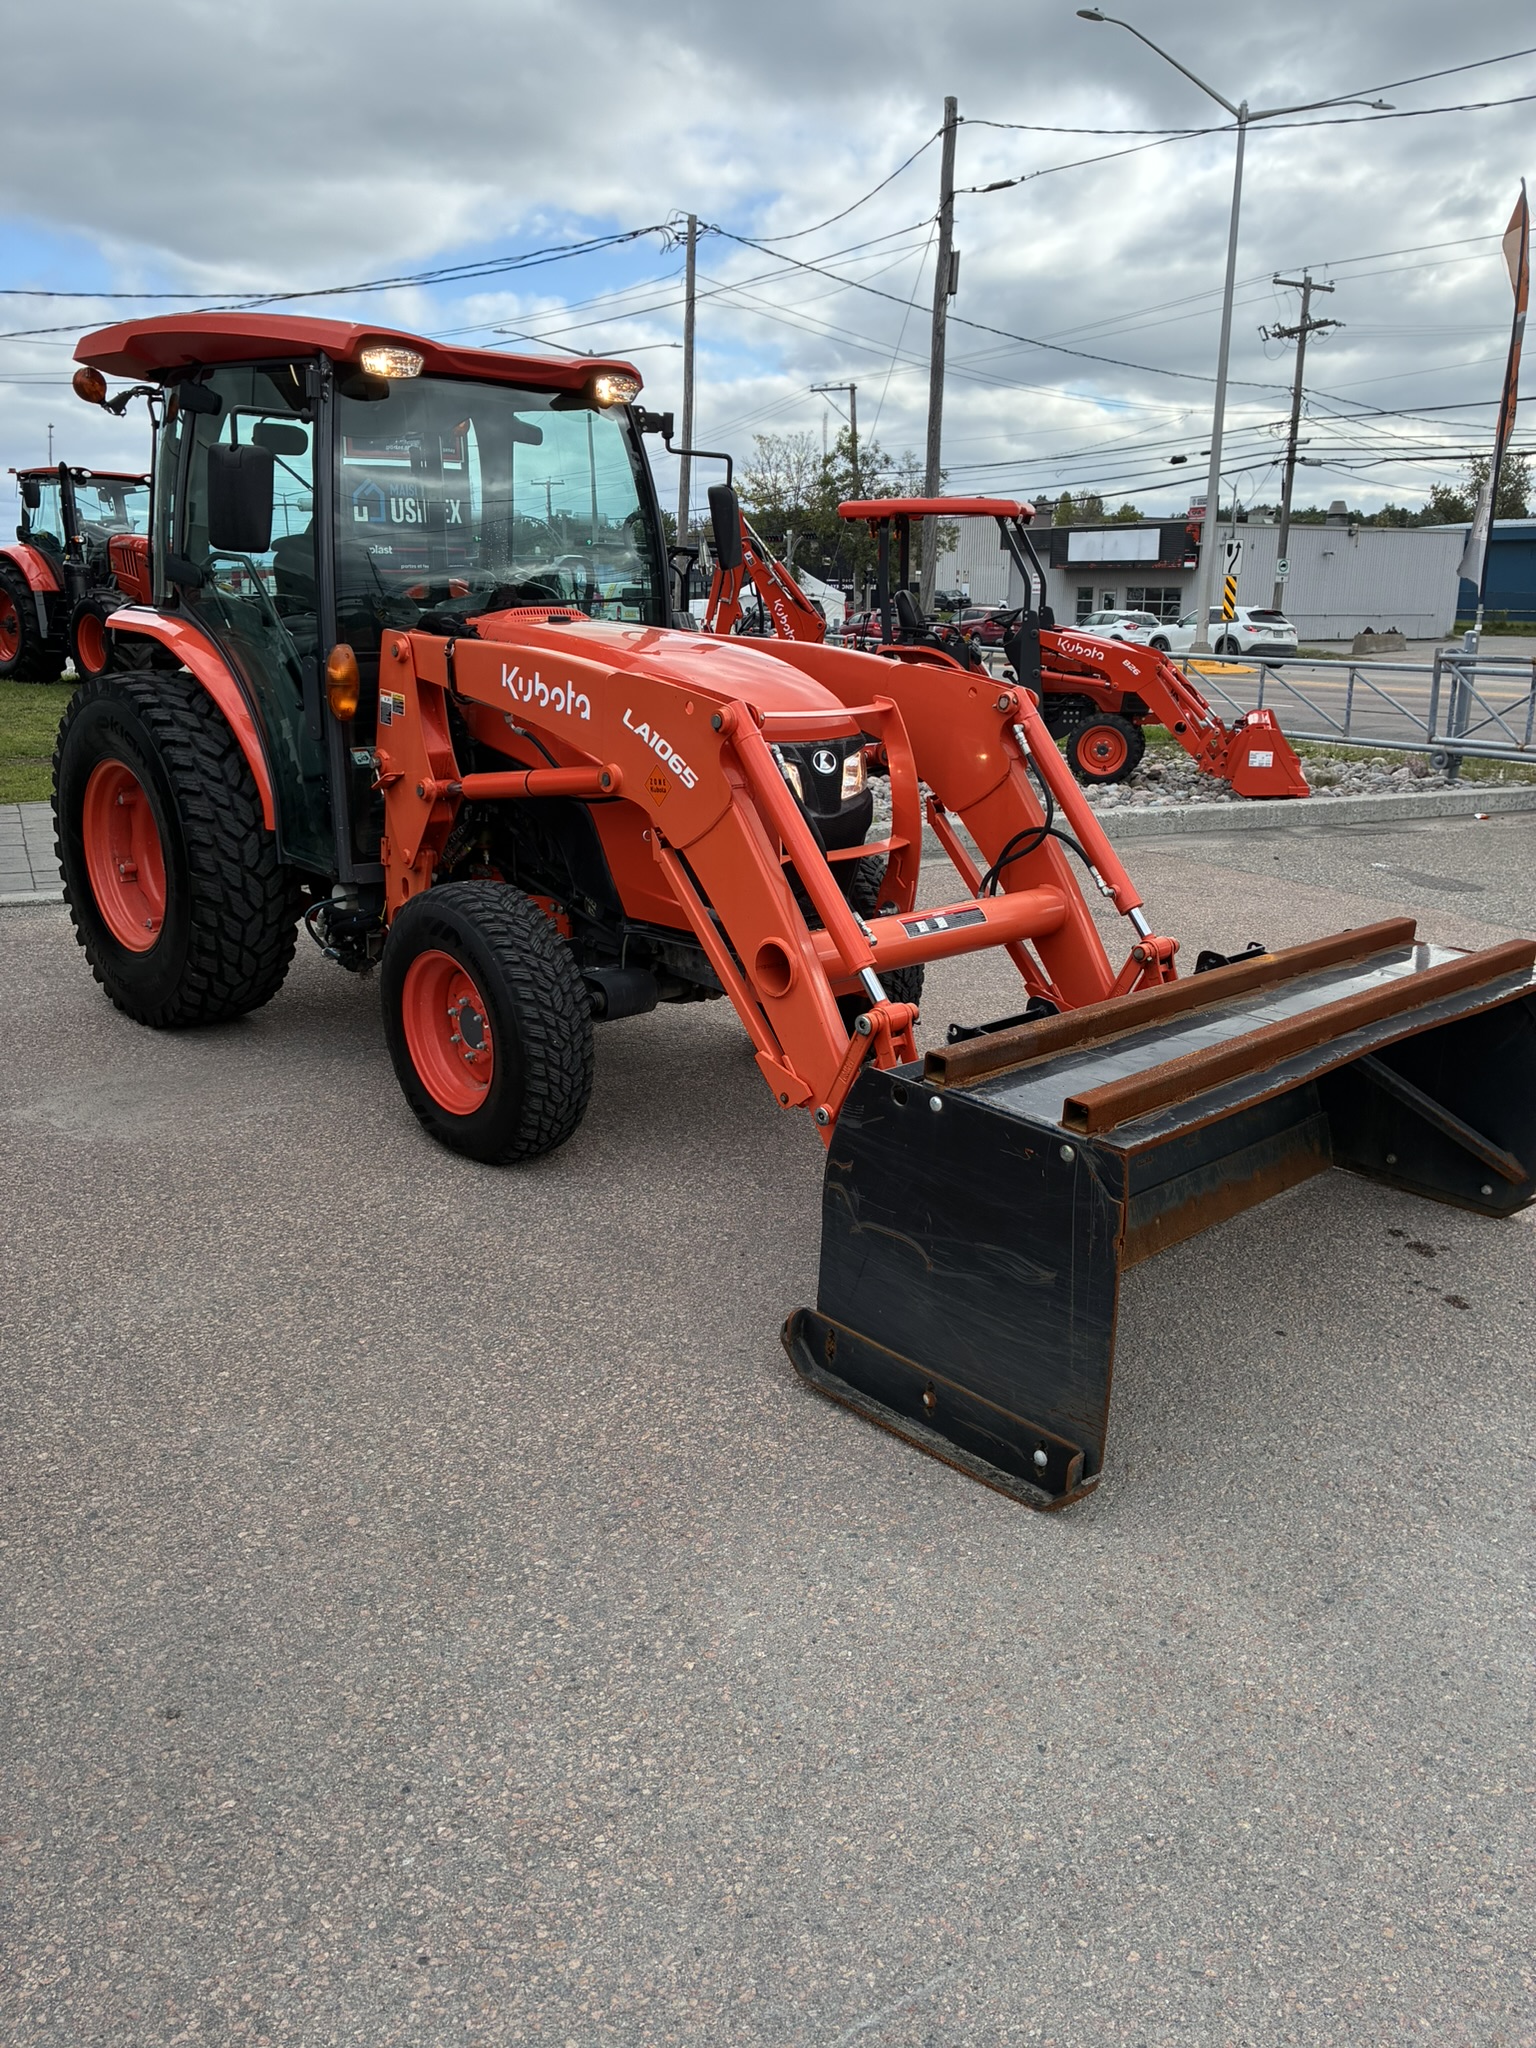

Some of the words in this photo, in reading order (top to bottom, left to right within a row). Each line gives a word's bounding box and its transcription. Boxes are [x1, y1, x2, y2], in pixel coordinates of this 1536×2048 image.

[774, 598, 795, 641] Kubota
[1057, 637, 1105, 661] Kubota
[1122, 659, 1141, 676] B26
[501, 663, 591, 720] Kubota
[622, 708, 699, 789] LA1065
